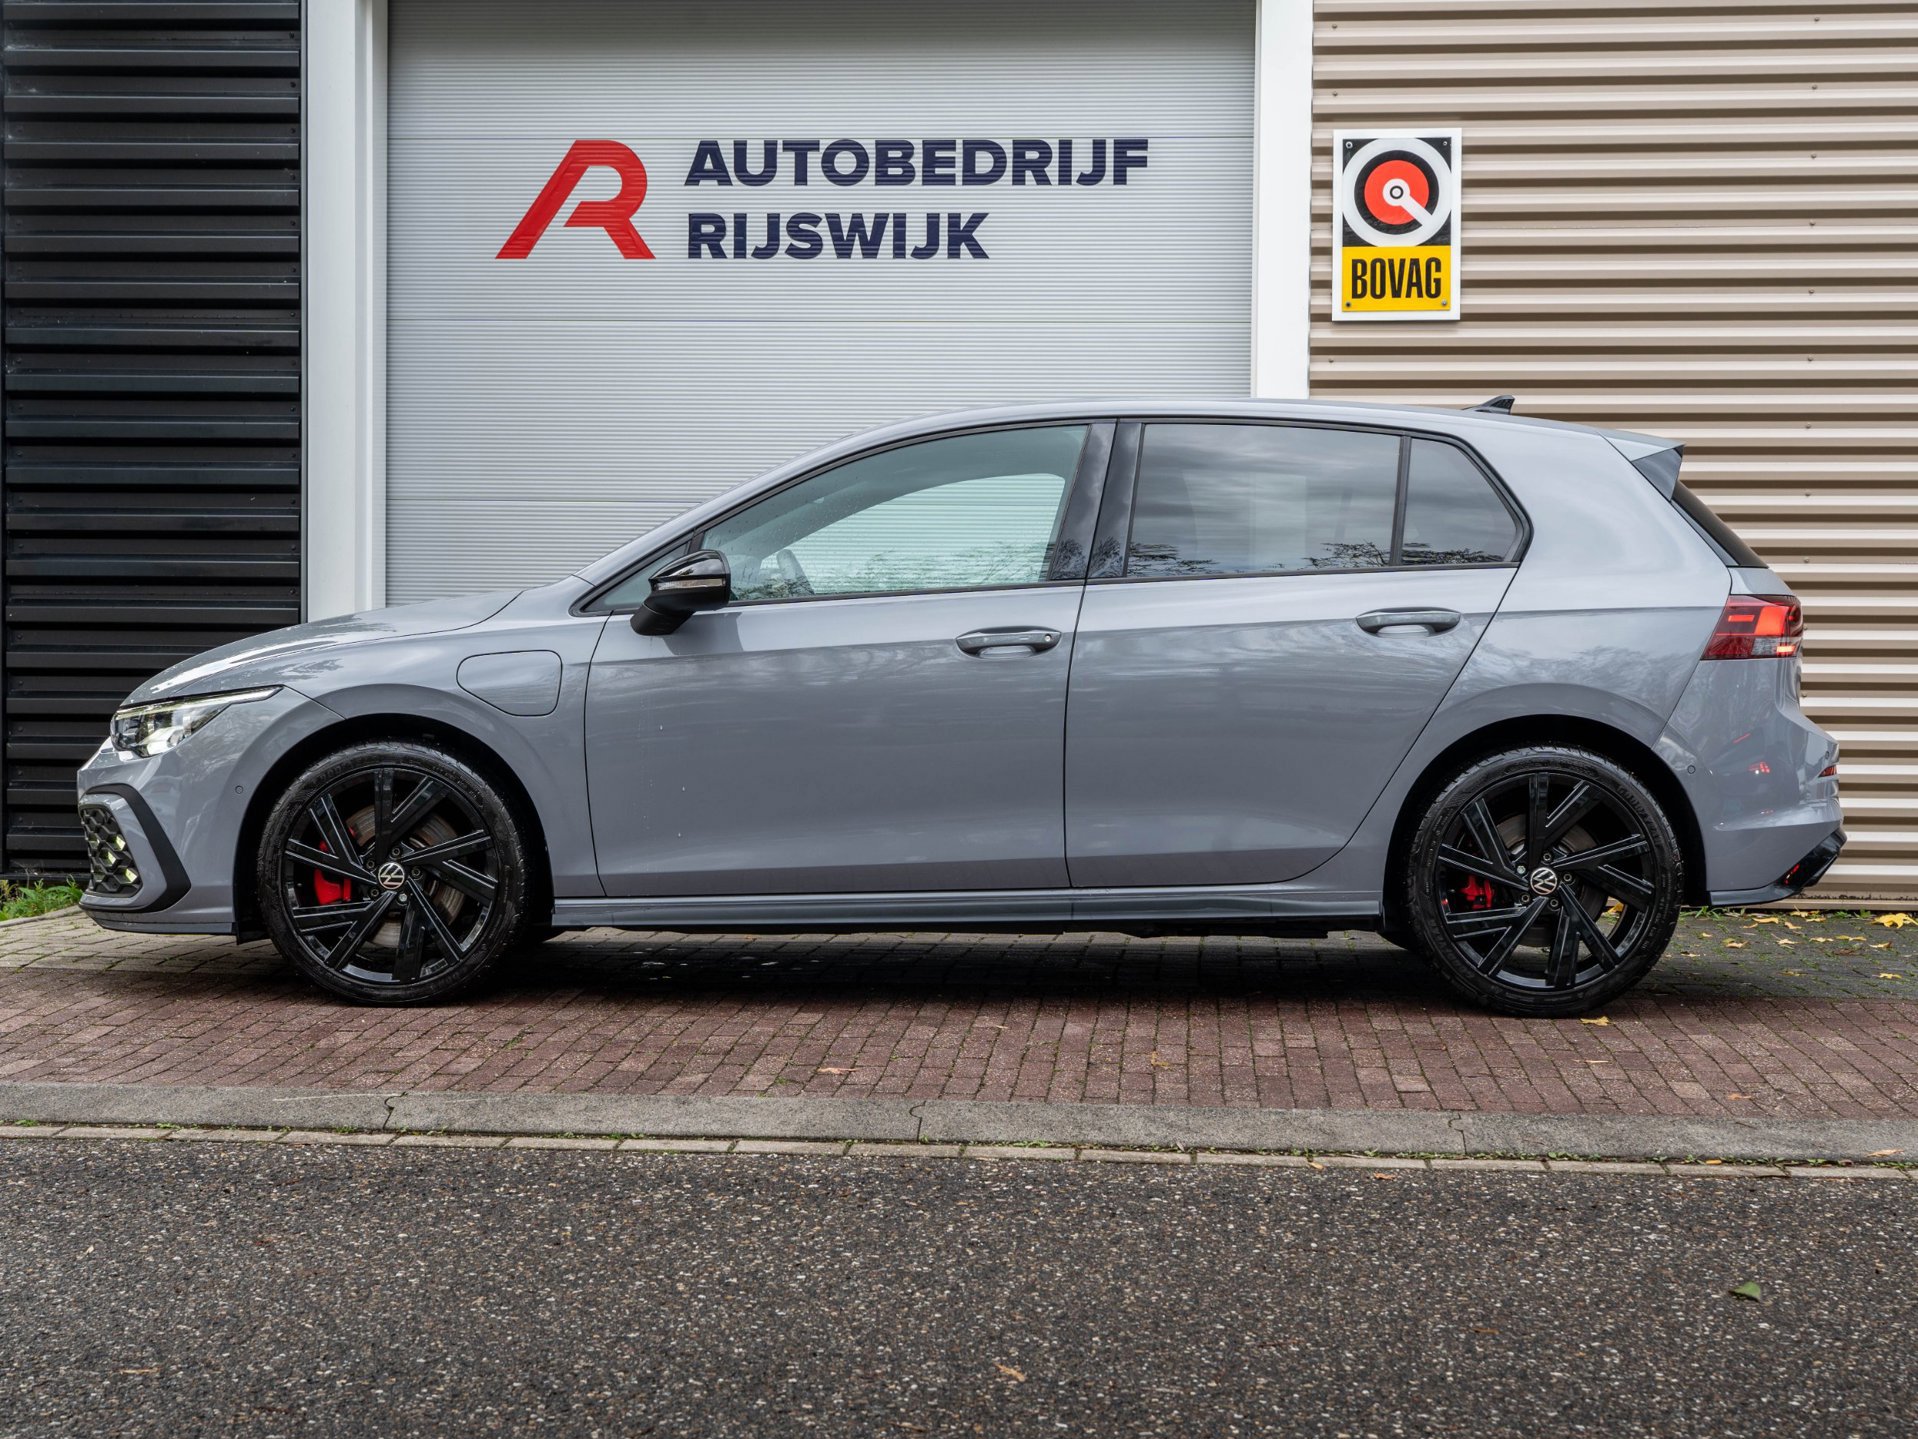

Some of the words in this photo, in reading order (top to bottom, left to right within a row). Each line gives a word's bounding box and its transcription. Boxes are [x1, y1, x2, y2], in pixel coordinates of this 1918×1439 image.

[685, 139, 1149, 187] AUTOBEDRIJF
[688, 212, 990, 260] RIJSWIJK
[1351, 257, 1442, 299] BOVAG
